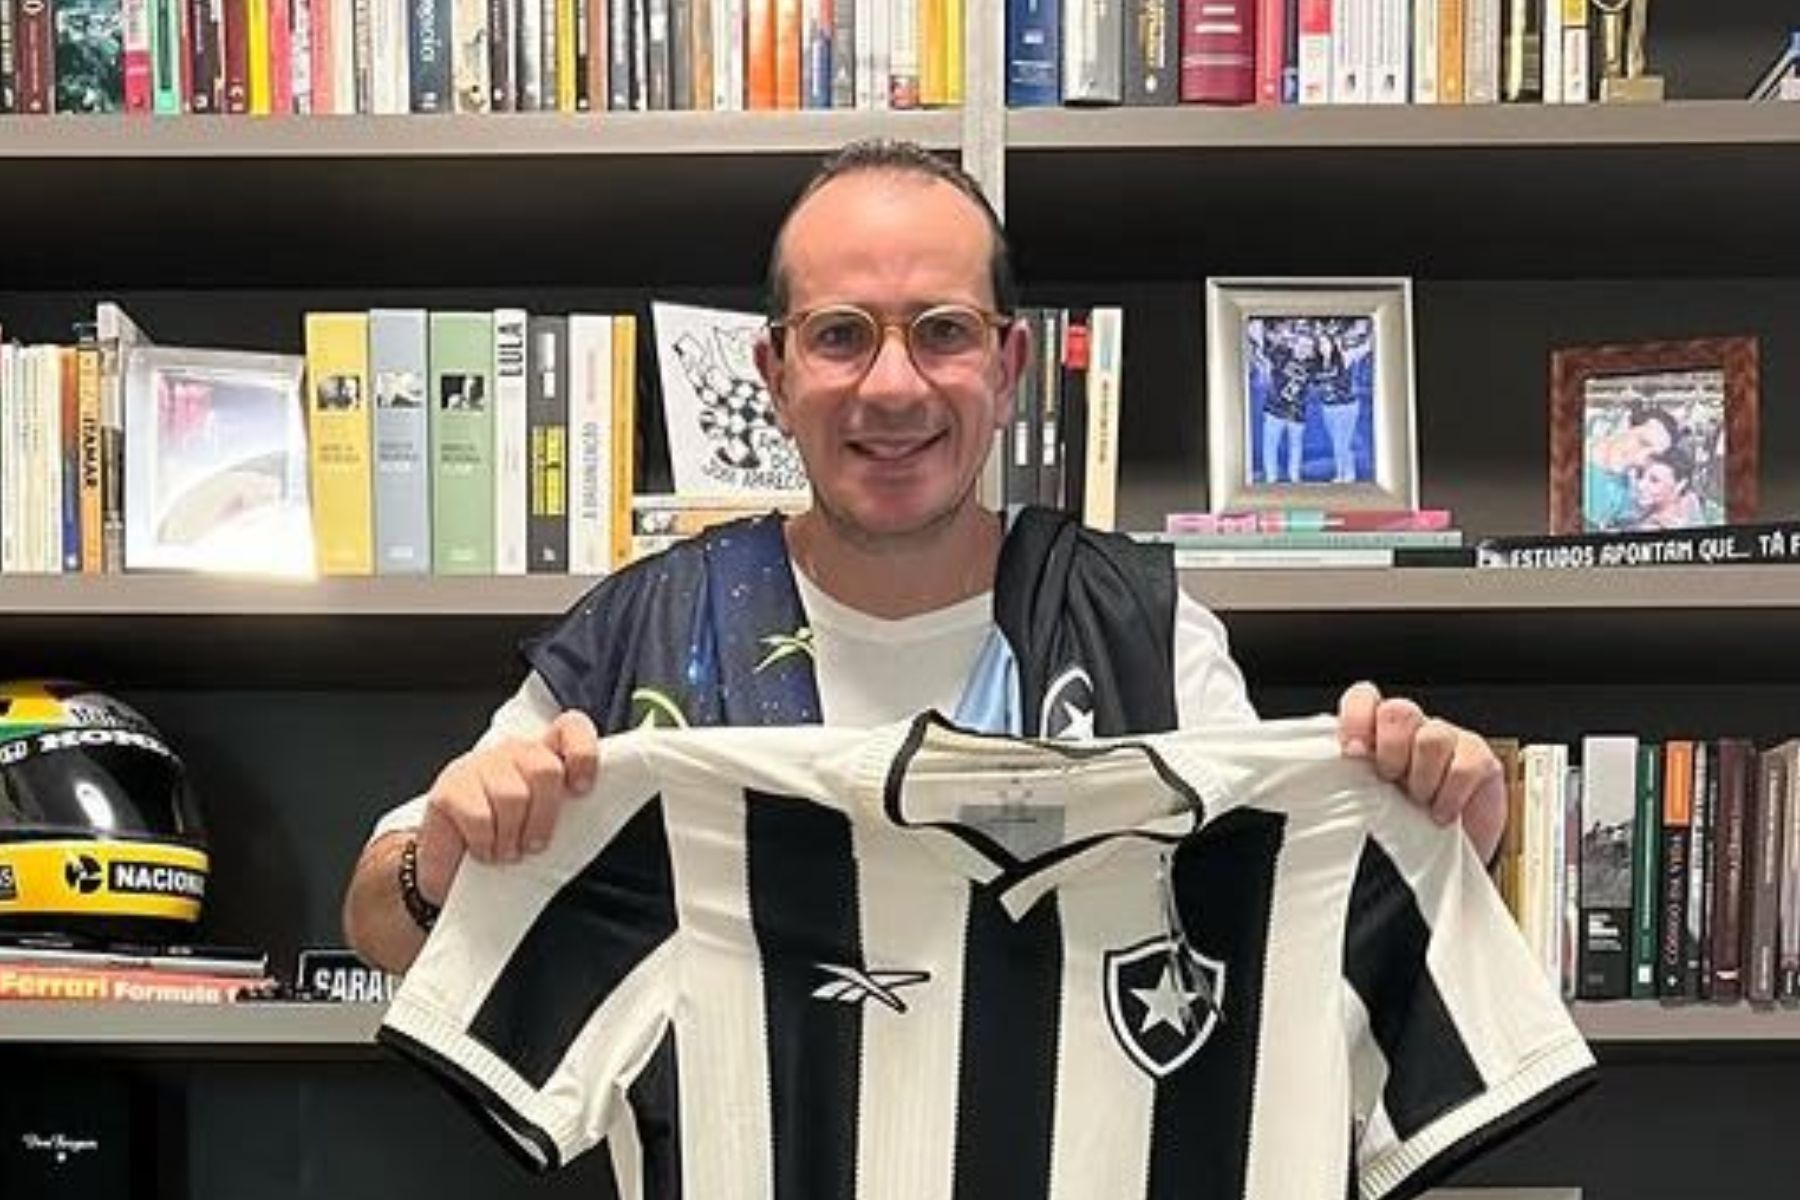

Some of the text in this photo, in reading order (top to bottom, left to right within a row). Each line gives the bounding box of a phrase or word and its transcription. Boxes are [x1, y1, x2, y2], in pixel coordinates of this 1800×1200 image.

[498, 321, 523, 378] LULA
[82, 417, 98, 487] ITAMAR
[1510, 546, 1594, 568] ESTUDOS
[1600, 539, 1693, 565] APONTAM
[0, 971, 107, 998] Ferrari
[115, 981, 219, 1001] Formula
